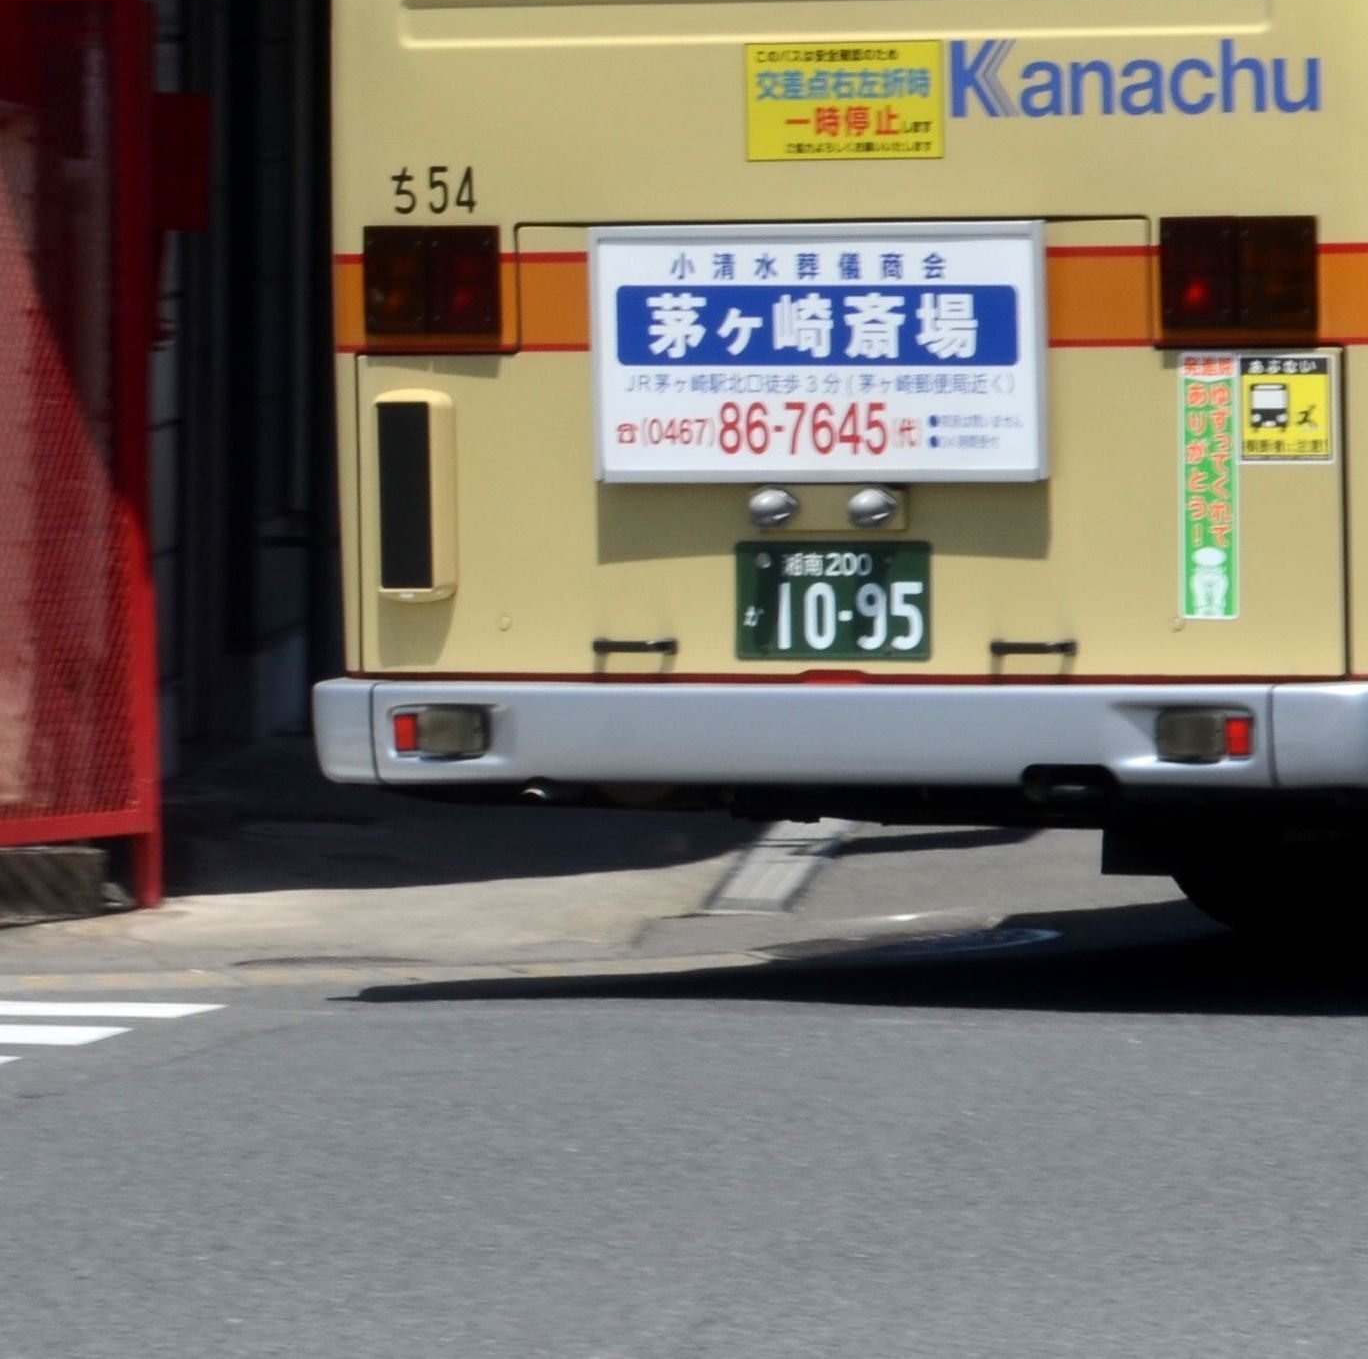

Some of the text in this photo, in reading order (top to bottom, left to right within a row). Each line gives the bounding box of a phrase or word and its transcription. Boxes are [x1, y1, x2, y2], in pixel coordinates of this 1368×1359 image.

[756, 68, 931, 101] 交差点右左折時
[950, 38, 1321, 119] Kanachu
[670, 252, 949, 281] 小清水葬儀商会
[646, 292, 979, 360] 茅ヶ崎斎場
[777, 581, 924, 651] 10-95
